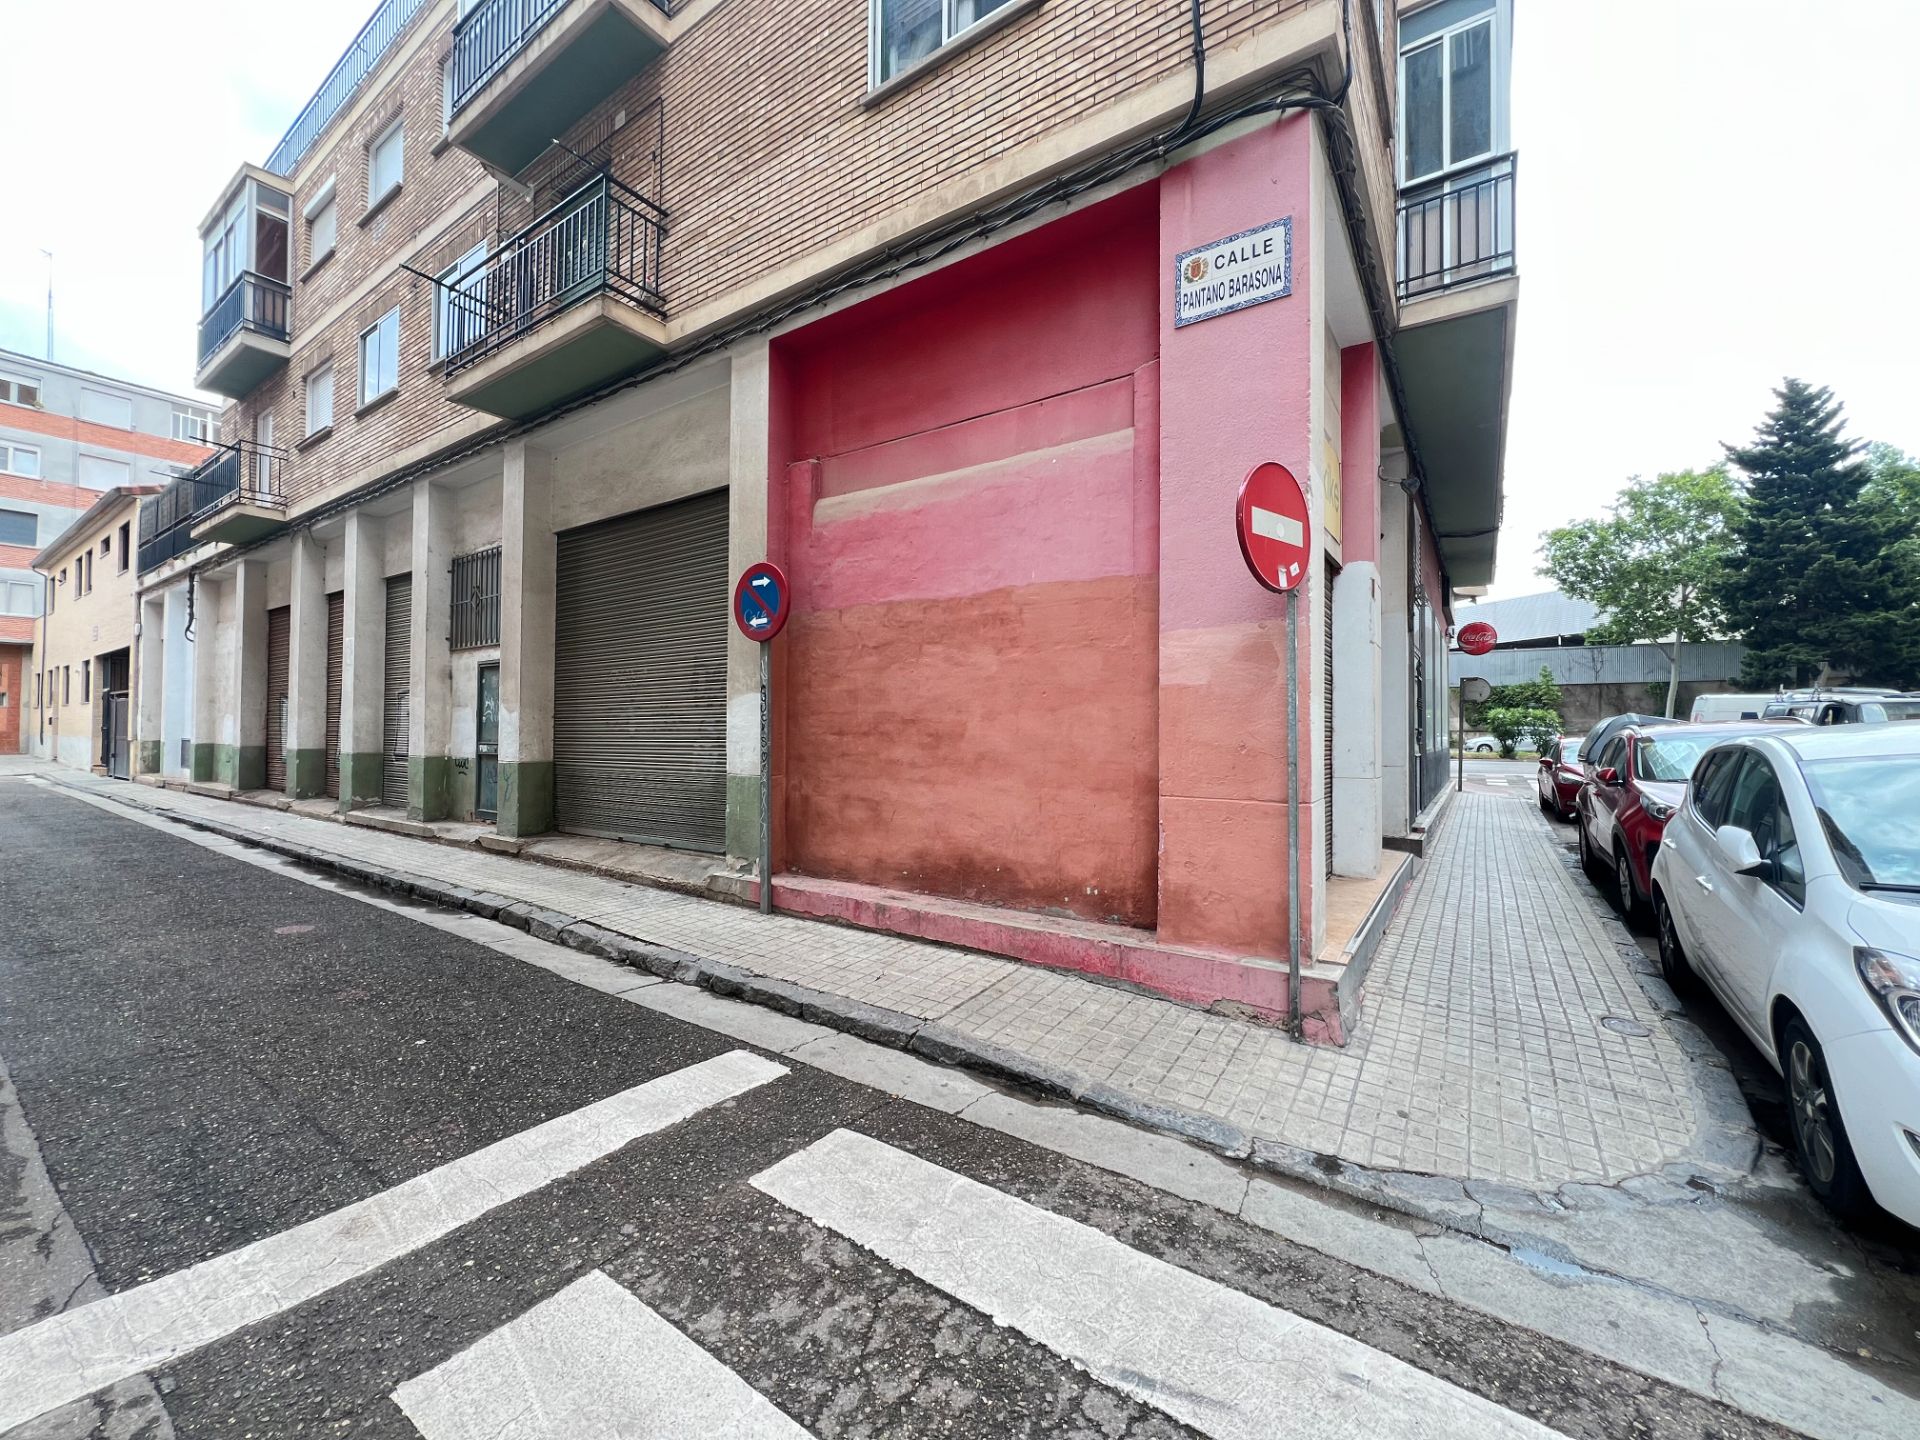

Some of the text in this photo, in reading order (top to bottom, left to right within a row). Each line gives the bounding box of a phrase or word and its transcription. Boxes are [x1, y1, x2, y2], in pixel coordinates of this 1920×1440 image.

[1214, 238, 1273, 269] CALLE
[1183, 264, 1282, 312] PANTANO BARASONA
